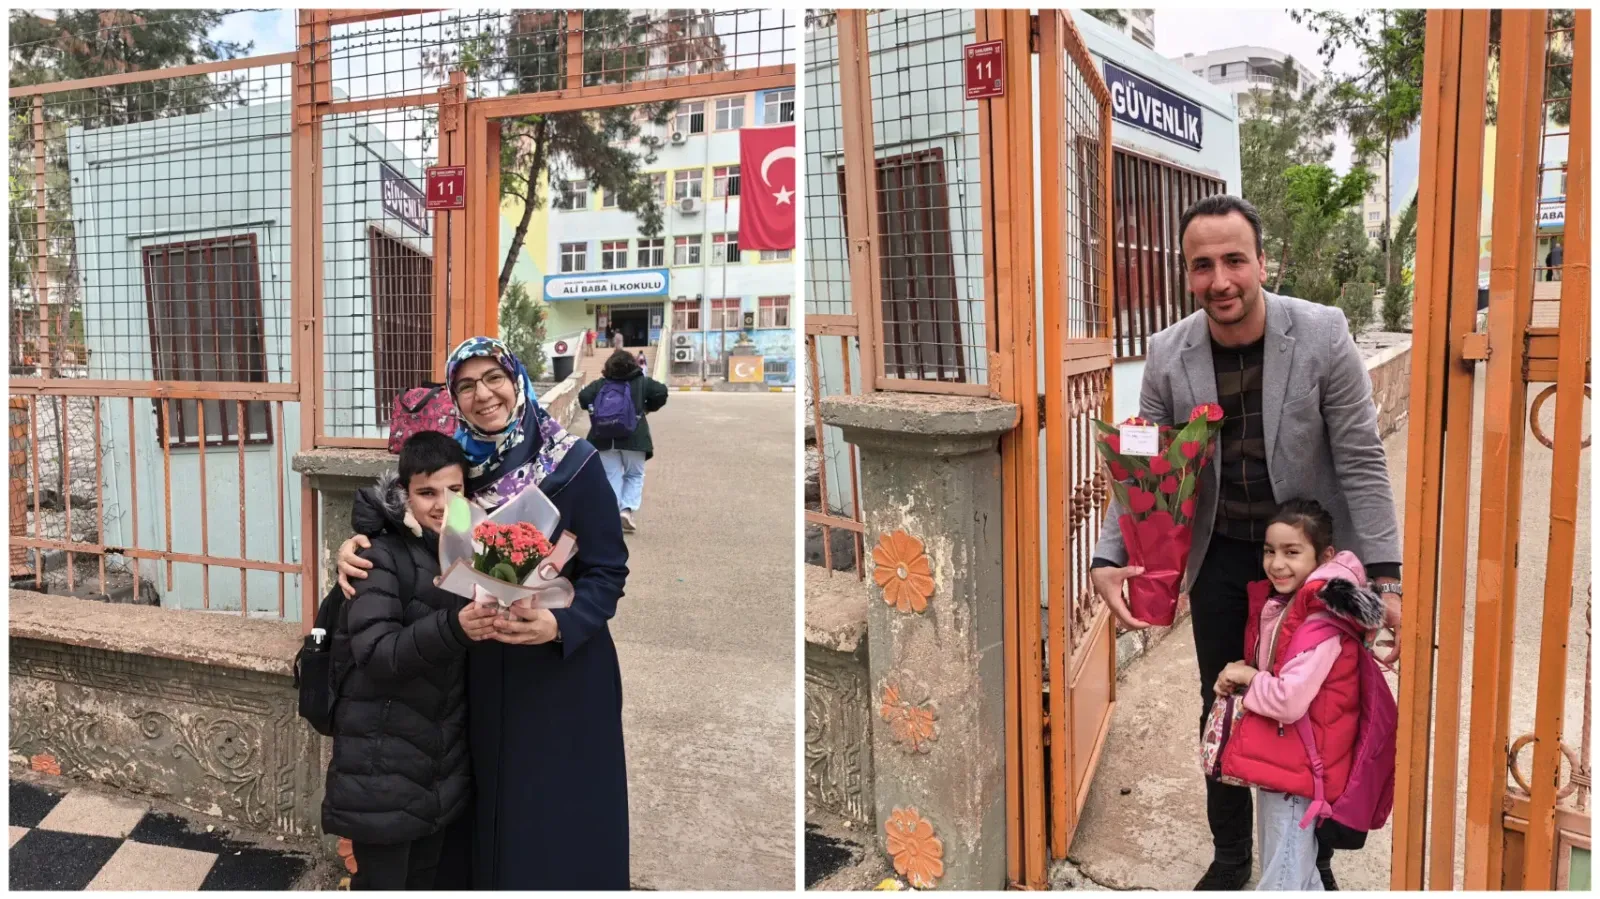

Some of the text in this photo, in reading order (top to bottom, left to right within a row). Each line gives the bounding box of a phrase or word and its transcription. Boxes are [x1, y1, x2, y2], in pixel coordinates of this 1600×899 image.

[976, 60, 992, 80] 11
[1111, 79, 1200, 144] GÜVENLİK
[437, 180, 454, 196] 11
[1537, 212, 1563, 220] ABA
[563, 285, 579, 294] ALİ
[581, 284, 607, 293] BABA
[610, 281, 661, 292] İLKOKULU
